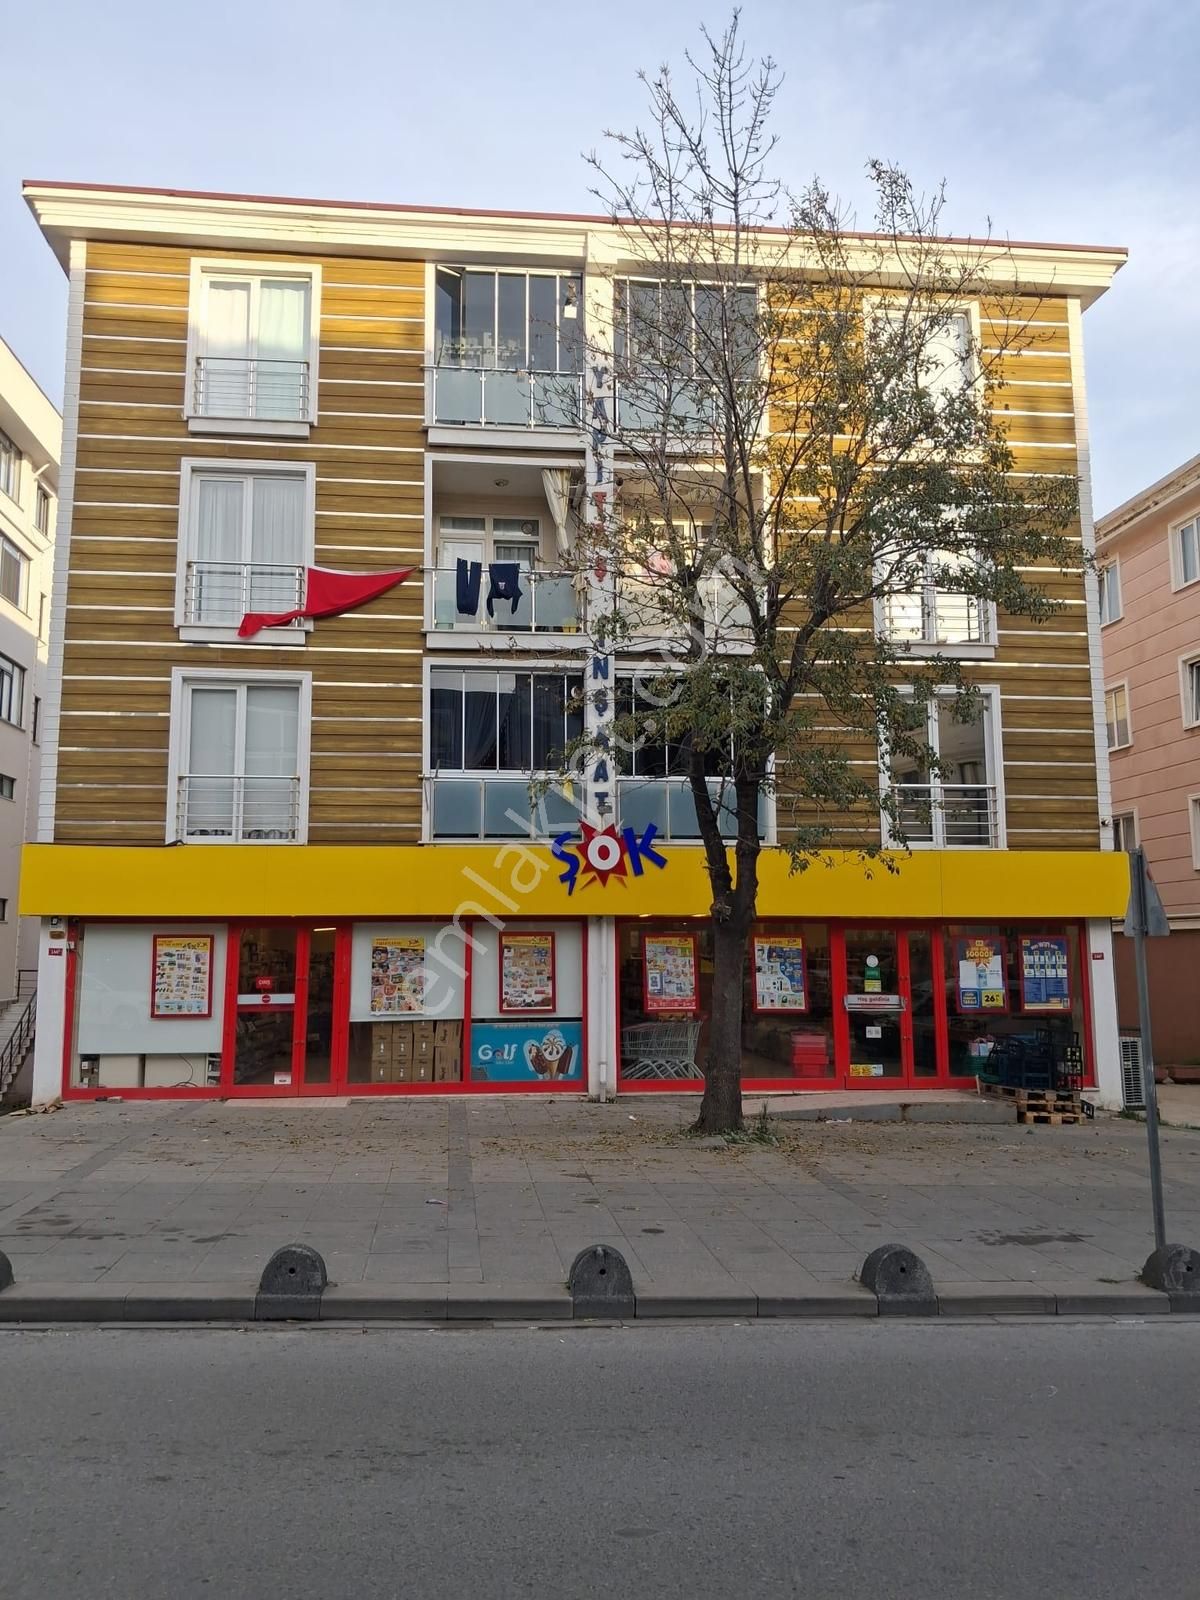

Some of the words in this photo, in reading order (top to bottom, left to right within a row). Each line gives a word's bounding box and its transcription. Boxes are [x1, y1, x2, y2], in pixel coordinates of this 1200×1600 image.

[551, 822, 667, 896] ŞOK
[984, 994, 995, 1002] 26
[478, 1044, 518, 1061] Golf
